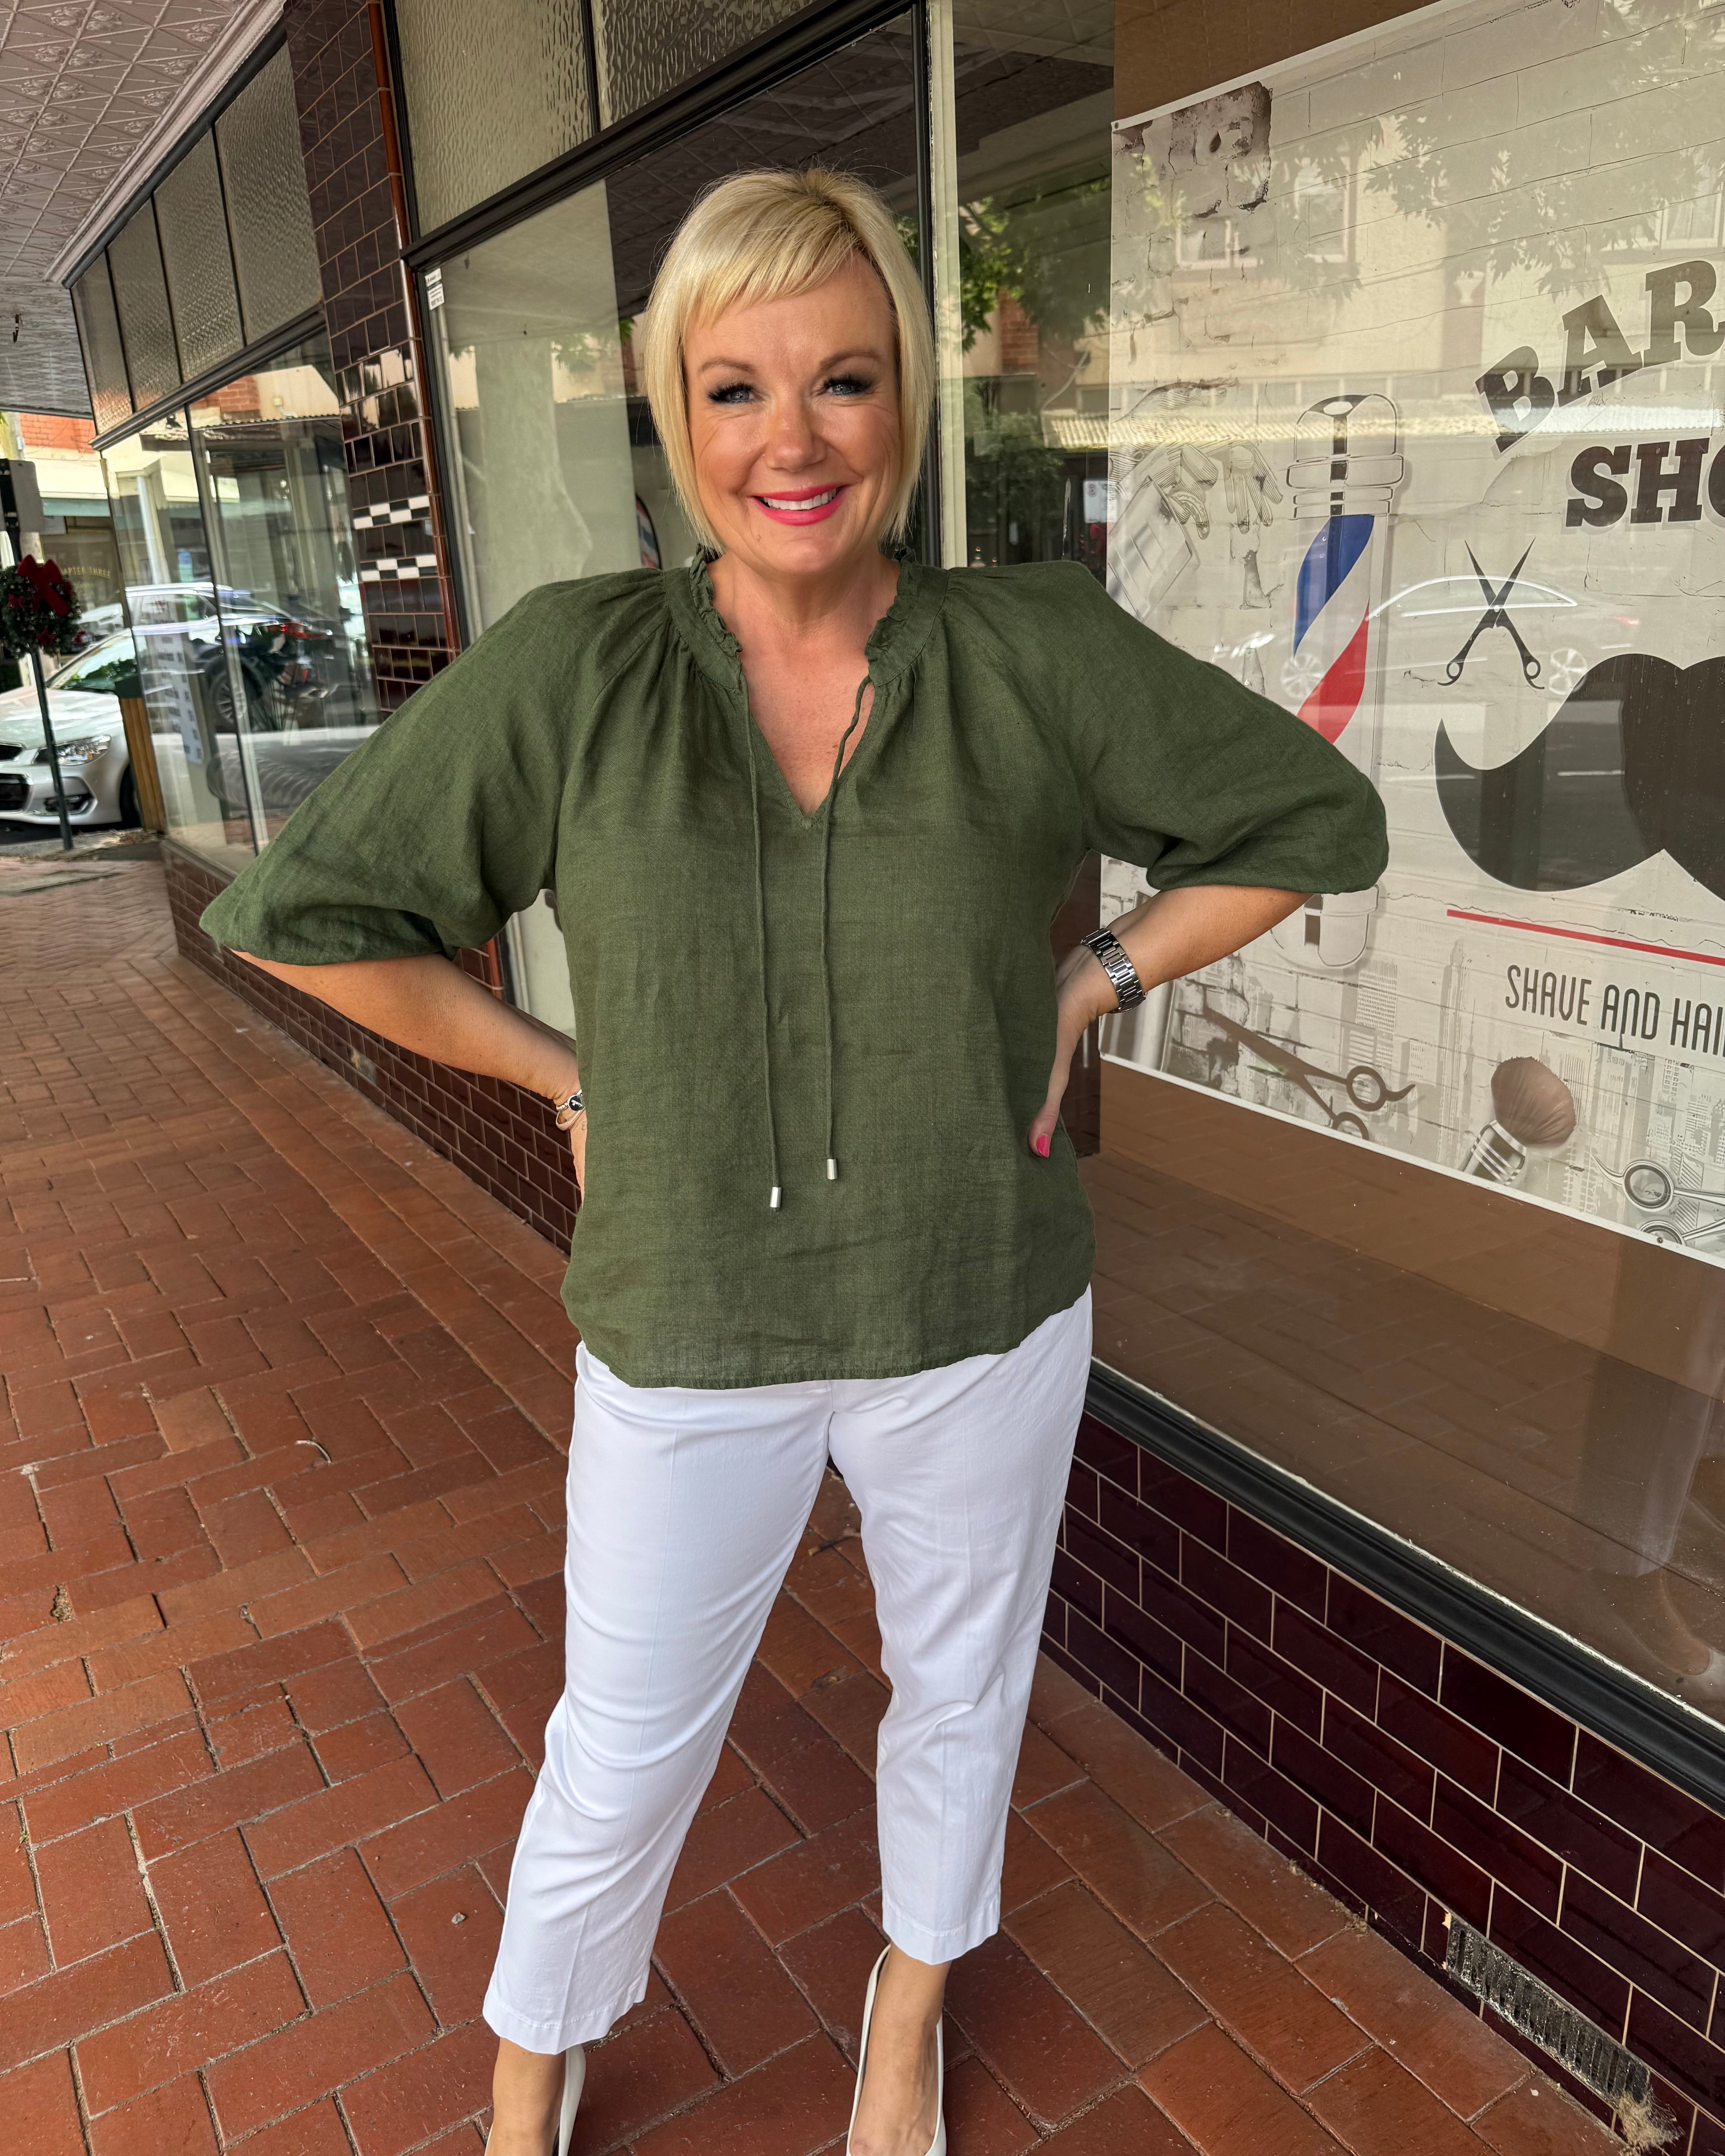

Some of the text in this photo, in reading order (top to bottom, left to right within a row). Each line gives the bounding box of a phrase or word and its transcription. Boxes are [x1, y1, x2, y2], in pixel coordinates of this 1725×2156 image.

[1505, 965, 1725, 1057] SHAVE AND HAI
